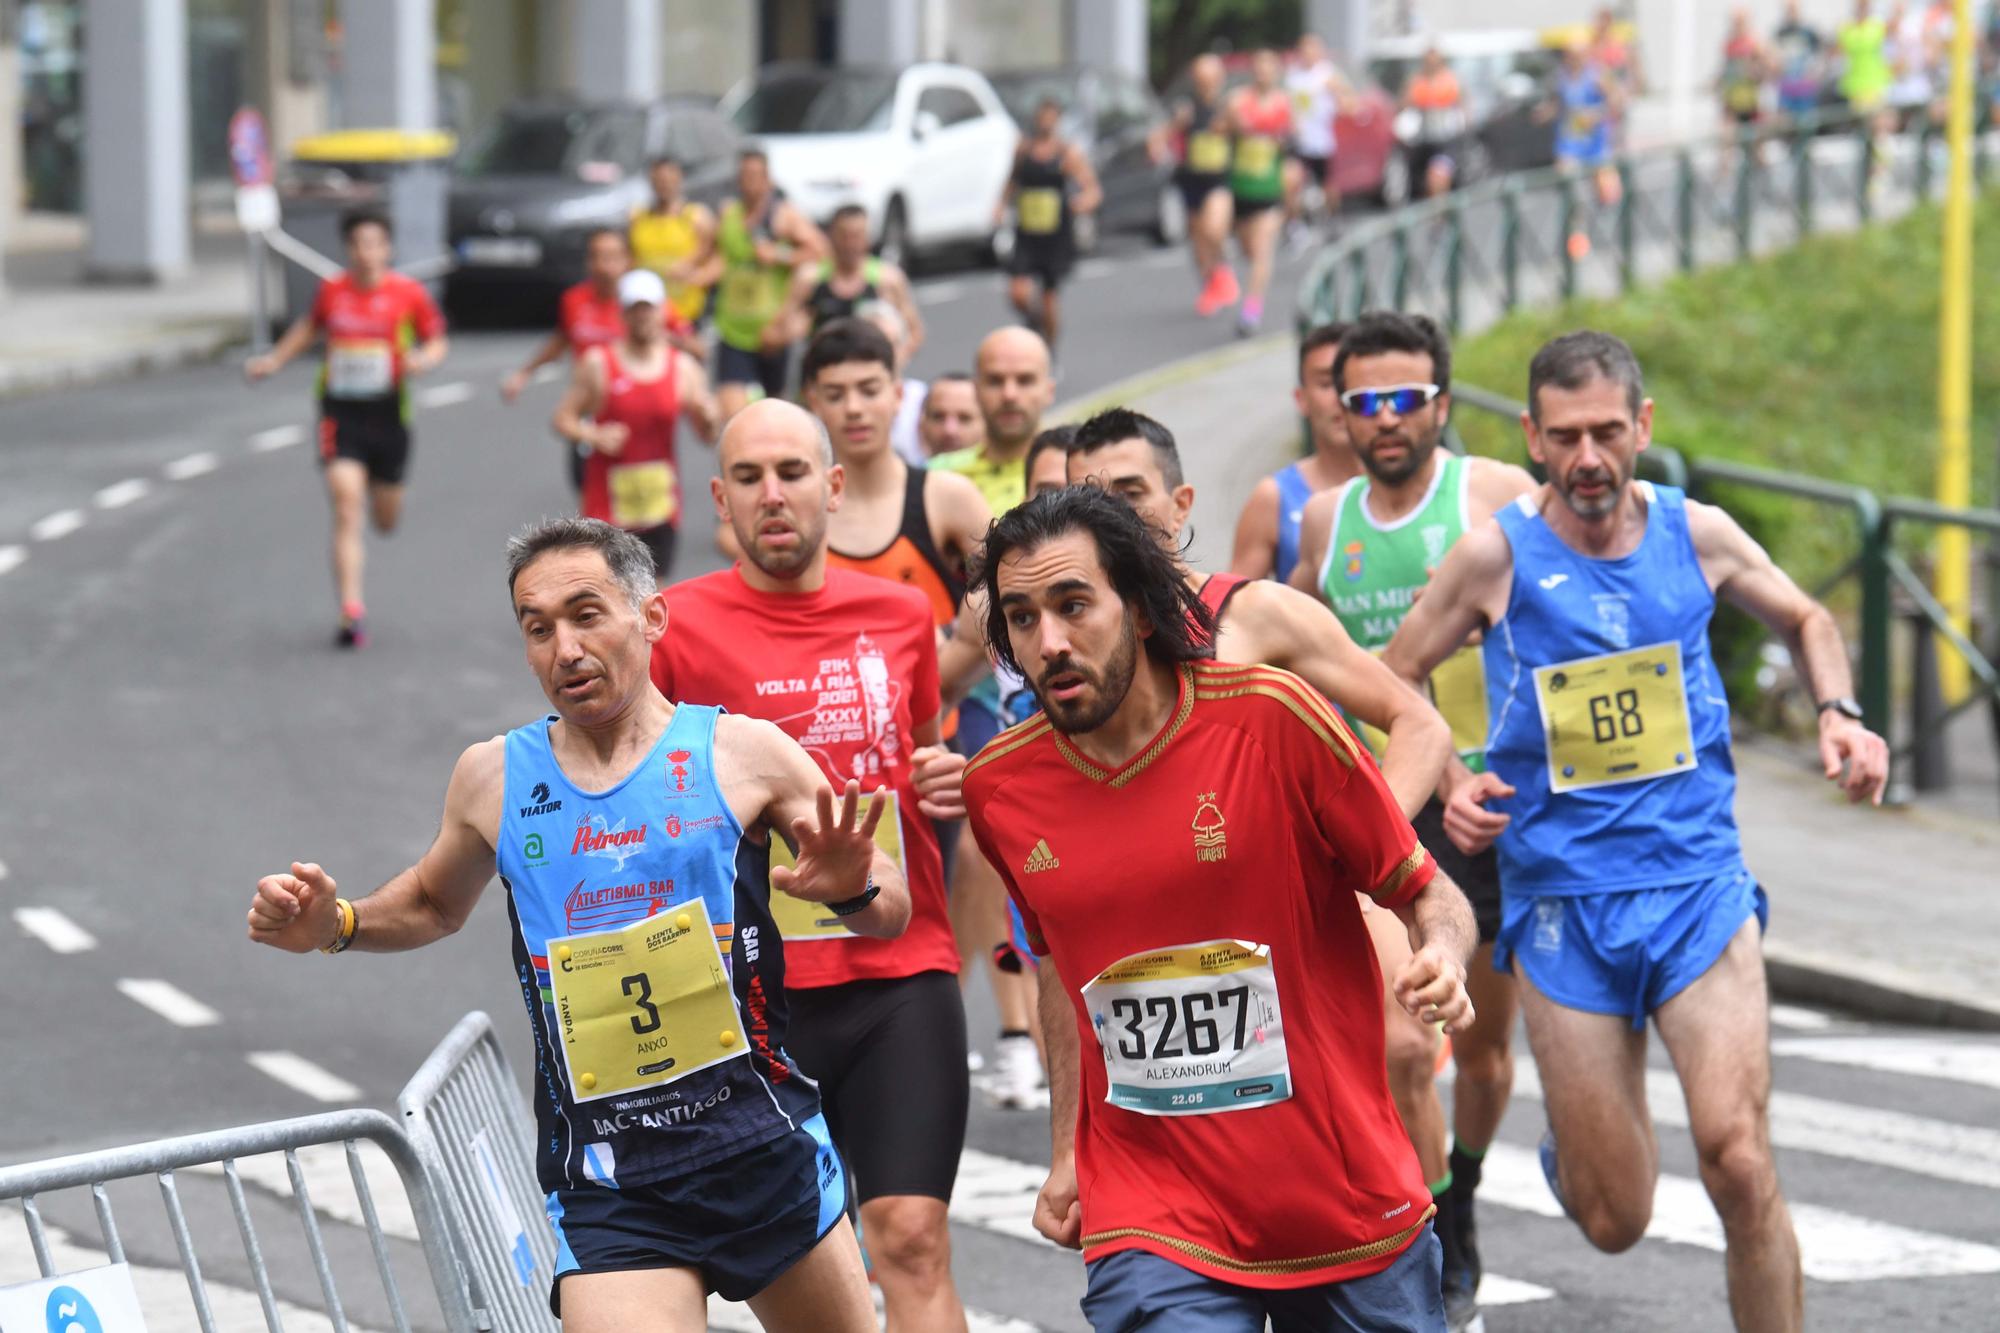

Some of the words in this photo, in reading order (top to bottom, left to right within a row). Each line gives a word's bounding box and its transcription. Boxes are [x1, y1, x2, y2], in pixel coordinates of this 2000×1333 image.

[819, 658, 850, 674] 21K
[755, 679, 806, 697] VOLTA
[818, 689, 858, 705] 2021
[813, 706, 863, 725] XXXV
[1589, 688, 1644, 744] 68
[807, 722, 863, 735] MEMORIAL
[798, 732, 841, 746] ADOLFO
[520, 800, 562, 818] VIATOR
[684, 815, 724, 827] Deputación
[571, 824, 647, 856] Petroni
[1023, 857, 1060, 874] adidas
[576, 883, 645, 908] ATLETISMO
[649, 879, 674, 895] SAR
[647, 940, 662, 949] DOS
[661, 927, 691, 946] BARRIOS
[652, 927, 673, 941] XENTE
[741, 925, 760, 963] SAR
[1200, 958, 1218, 966] DOS
[1218, 952, 1251, 965] BARRIOS
[1207, 949, 1231, 960] XENTE
[621, 972, 661, 1035] 3
[560, 996, 574, 1035] TANDA
[1111, 985, 1249, 1060] 3267
[637, 1036, 668, 1055] ANXO
[1146, 1061, 1232, 1080] ALEXANDRUM
[615, 1090, 681, 1111] INMOBILIARIOS
[1171, 1093, 1204, 1105] 22.05
